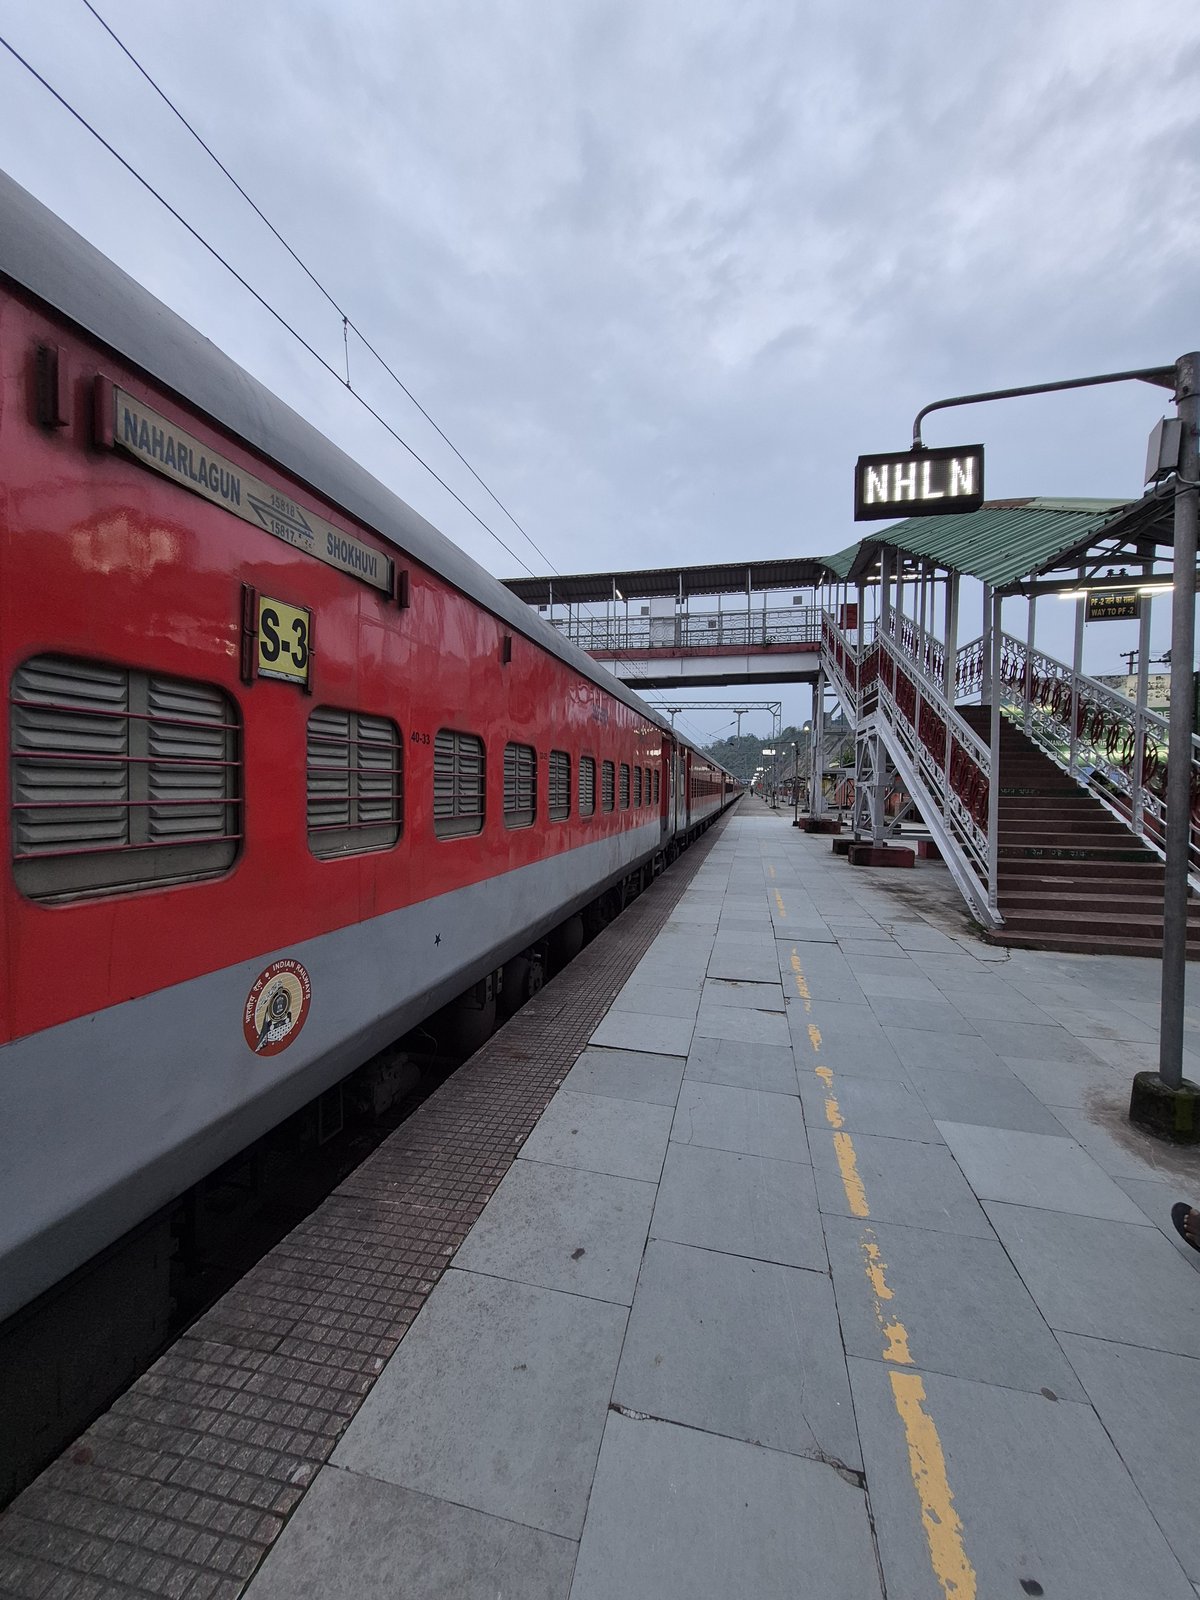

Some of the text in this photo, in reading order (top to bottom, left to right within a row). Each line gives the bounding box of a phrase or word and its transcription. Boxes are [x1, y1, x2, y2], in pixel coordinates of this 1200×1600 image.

[123, 407, 241, 506] NAHARLAGUN
[271, 494, 295, 517] 15818
[271, 520, 295, 542] 15817
[326, 532, 378, 578] SHOKHUVI
[1091, 608, 1106, 616] WAY
[1107, 607, 1117, 616] TO
[260, 608, 308, 669] S-3
[411, 731, 431, 745] 40-33
[272, 961, 311, 1000] INDIAN RAILWAYS
